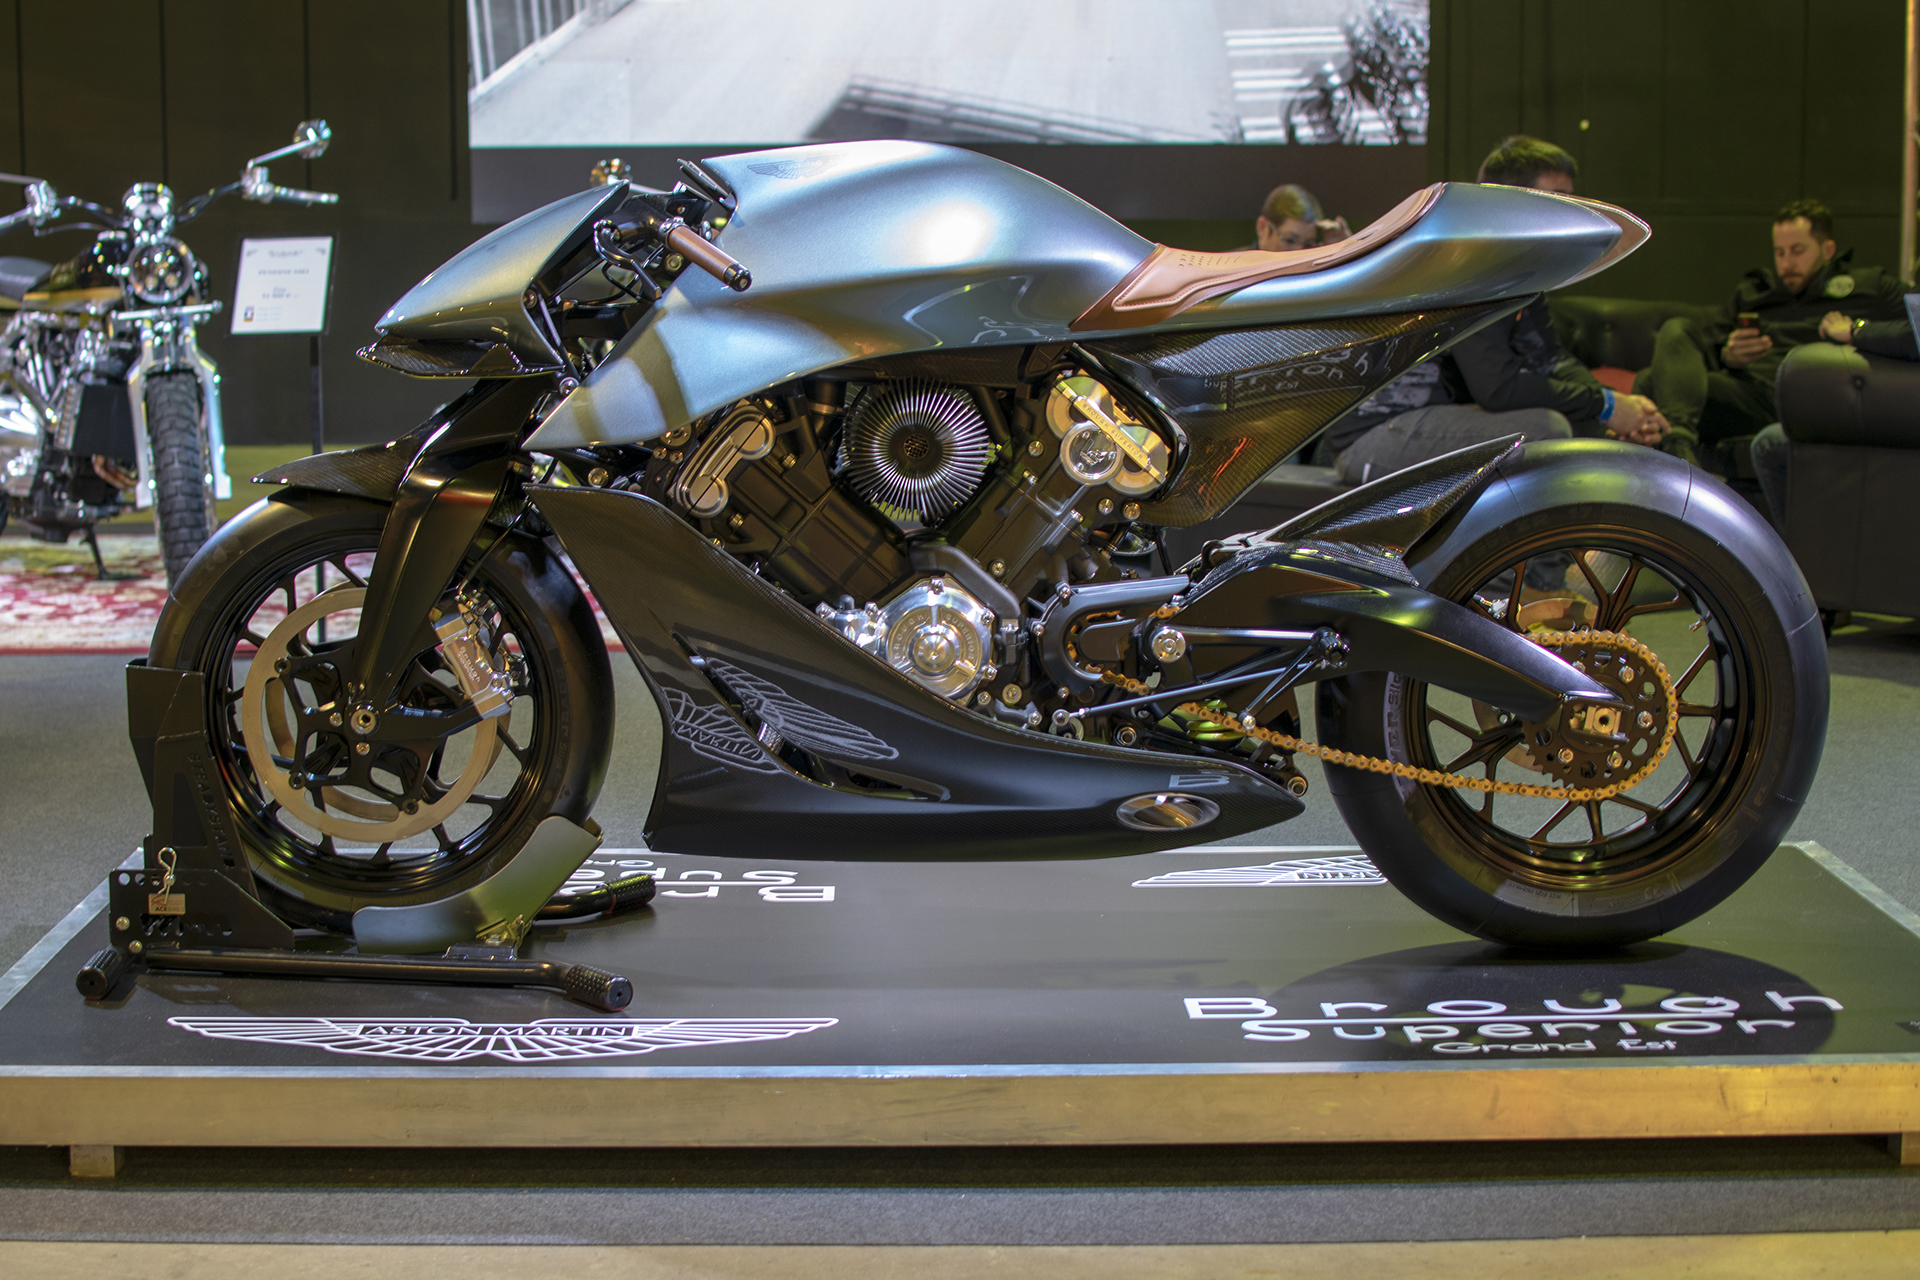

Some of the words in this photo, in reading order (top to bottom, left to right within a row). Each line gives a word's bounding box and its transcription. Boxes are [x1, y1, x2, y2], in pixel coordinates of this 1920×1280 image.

[1082, 403, 1109, 428] BROUGH
[1111, 429, 1143, 460] SUPERIOR
[1183, 991, 1844, 1020] Brough
[365, 1025, 483, 1036] ASTON
[493, 1025, 626, 1036] MARTIN
[1241, 1017, 1796, 1044] Superior
[1432, 1040, 1597, 1053] Grand
[1617, 1038, 1677, 1050] Est
